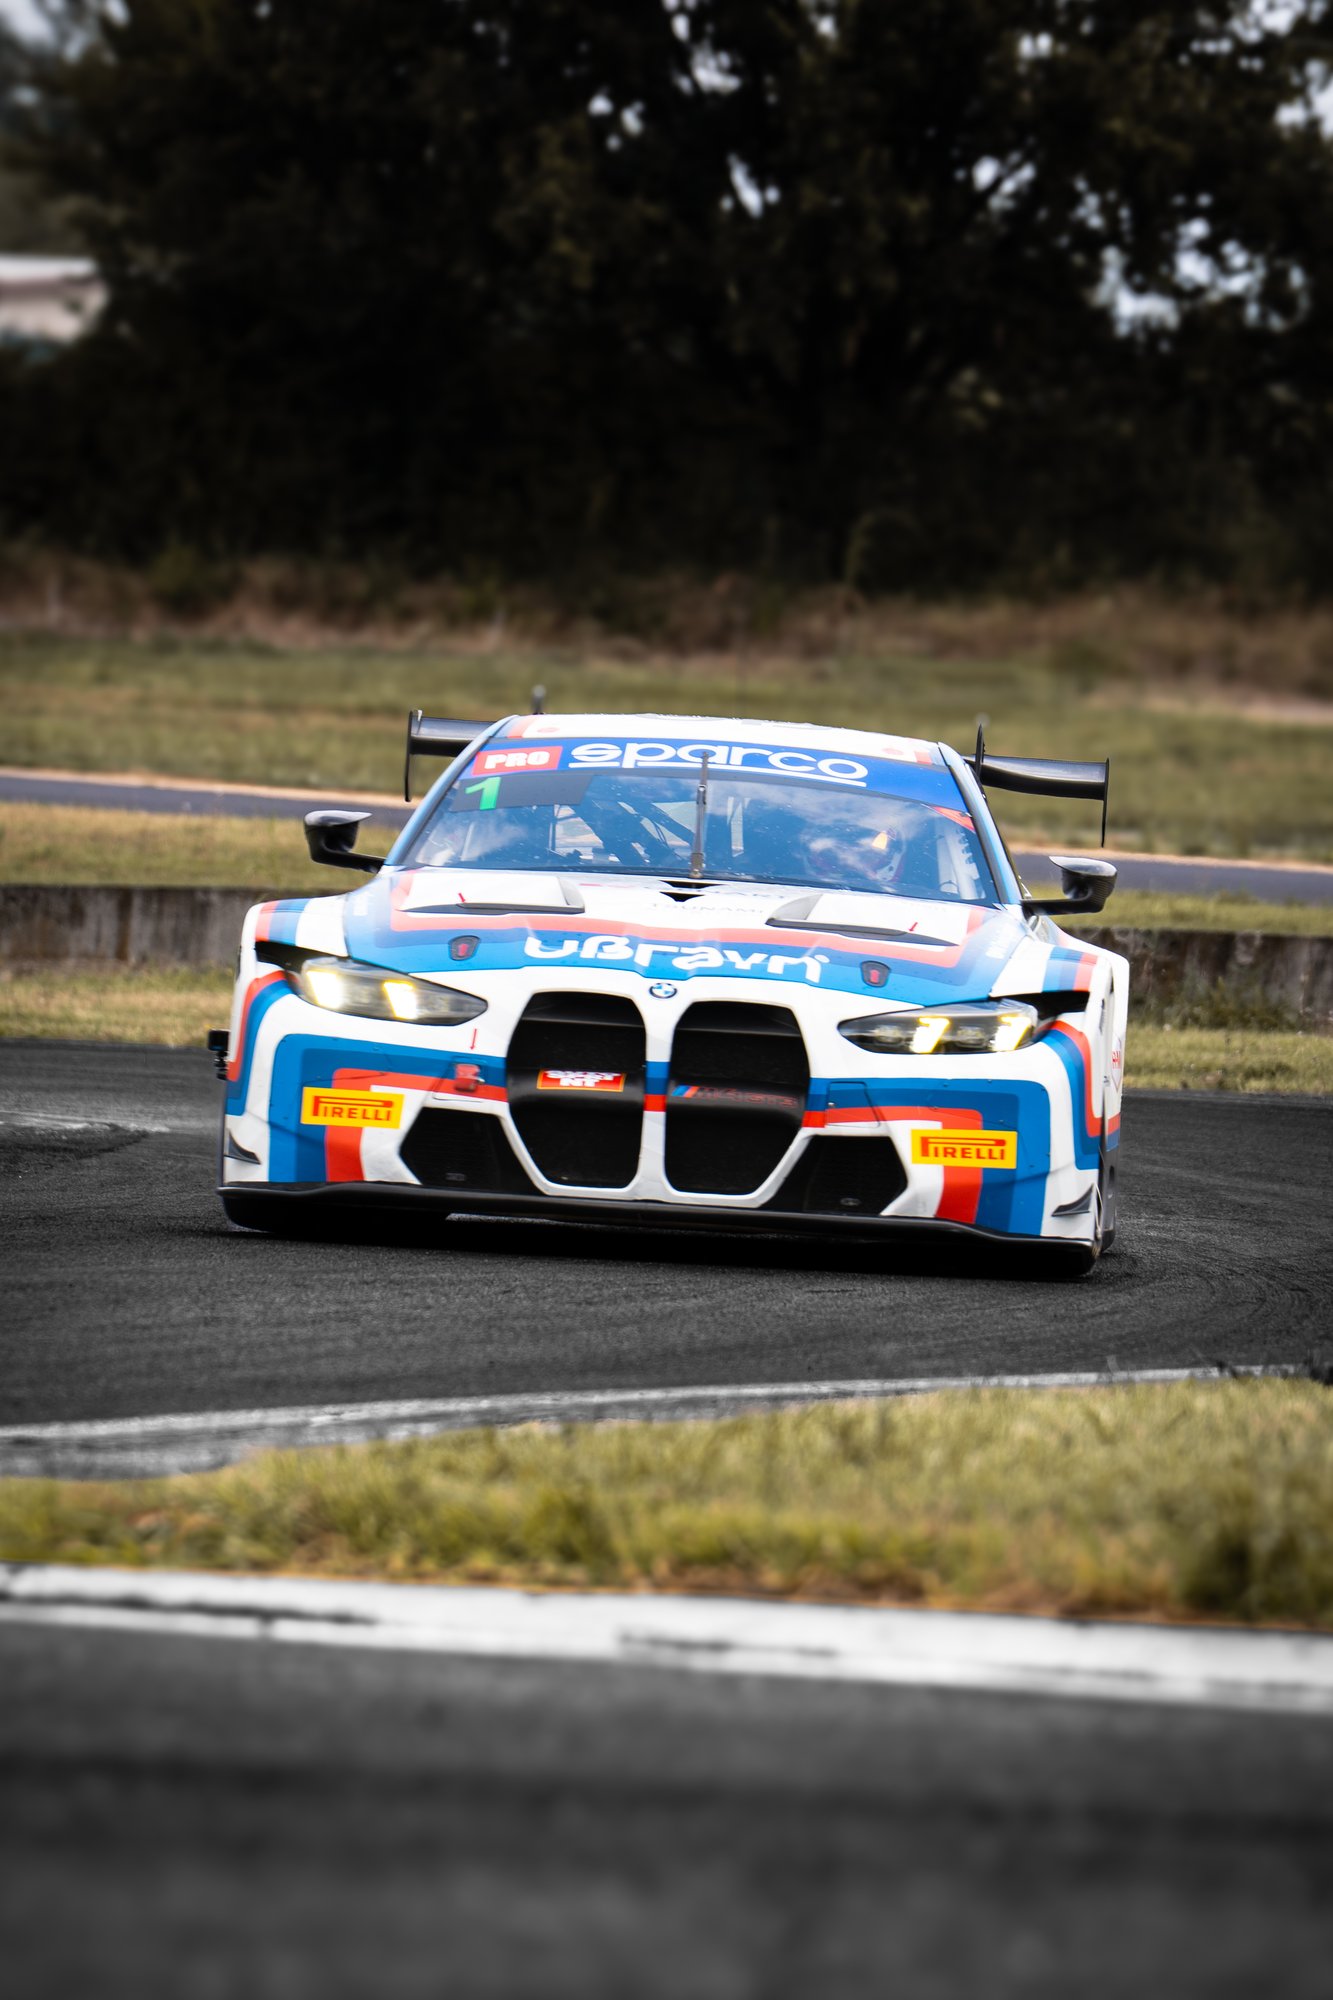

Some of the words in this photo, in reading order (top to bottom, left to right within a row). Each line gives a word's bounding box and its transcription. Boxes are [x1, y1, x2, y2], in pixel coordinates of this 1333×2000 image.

[484, 750, 550, 769] PRO
[570, 742, 869, 780] sparco
[465, 776, 501, 811] 1
[312, 1095, 393, 1122] PIRELLI
[920, 1136, 1007, 1161] PIRELLI
